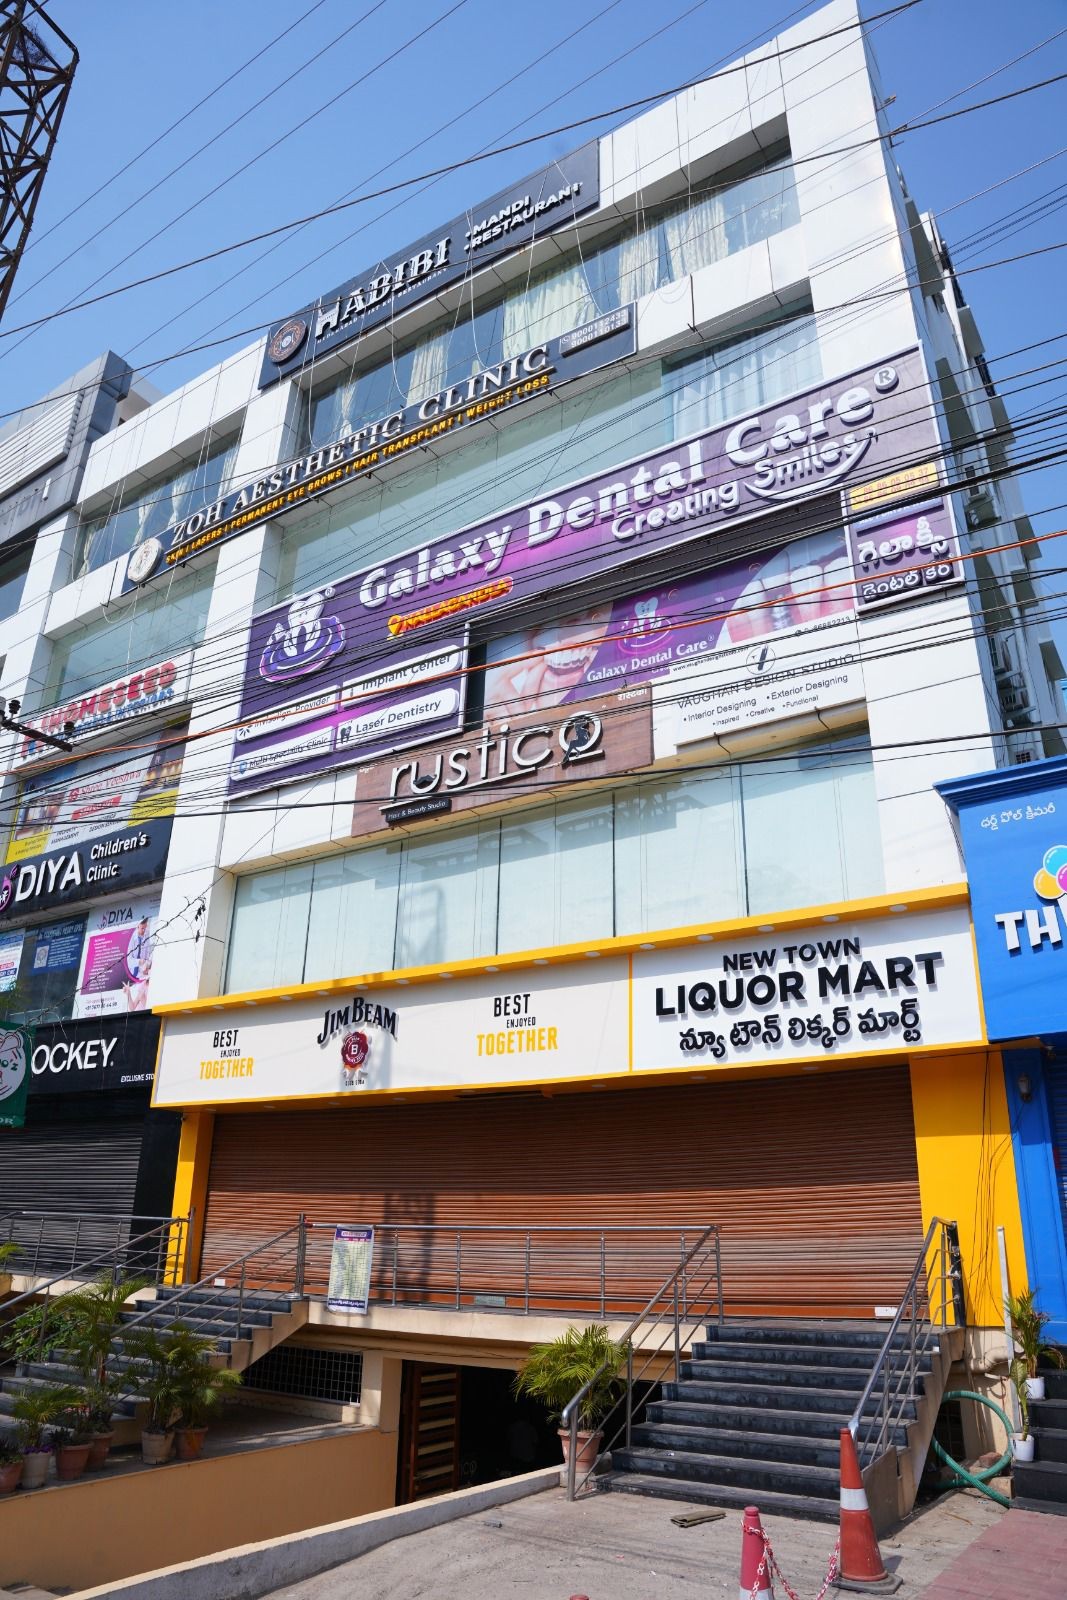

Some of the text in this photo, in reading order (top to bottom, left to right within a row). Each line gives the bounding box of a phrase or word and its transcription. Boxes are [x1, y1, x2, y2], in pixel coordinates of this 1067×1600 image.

[471, 182, 583, 248] RESTAURANT
[472, 195, 531, 236] MANDI
[315, 236, 451, 339] HABIBI
[171, 345, 548, 546] ZOH AESTHETIC CLINIC
[191, 527, 224, 550] LASERS
[230, 496, 286, 530] PERMANENT
[287, 485, 305, 502] EYE
[308, 469, 343, 492] BROWS
[352, 452, 379, 470] HAIR
[382, 416, 455, 456] TRANSPLANT
[517, 375, 550, 396] LOSS
[359, 524, 511, 608] Galaxy
[527, 441, 705, 547] Dental
[725, 385, 876, 467] Care
[610, 434, 868, 542] Creating Smiles
[587, 663, 627, 682] Galaxy
[631, 648, 672, 670] Dental
[676, 640, 708, 656] Care
[356, 699, 442, 734] Laser Dentistry
[688, 675, 848, 722] Interior Designing Exterior Designing
[716, 695, 819, 727] Inspired Creative Functional
[407, 805, 427, 816] Beauty
[427, 801, 446, 811] Studio
[90, 831, 147, 860] Children's
[15, 851, 81, 902] DIYA
[86, 861, 119, 882] Clinic
[108, 907, 133, 925] DIYA
[722, 937, 861, 972] NEW TOWN
[655, 951, 944, 1016] LIQUOR MART
[317, 996, 398, 1045] JIM BEAM
[493, 993, 531, 1018] BEST
[506, 1016, 536, 1029] ENJOYED
[213, 1029, 239, 1048] BEST
[476, 1026, 558, 1057] TOGETHER
[679, 998, 921, 1058] న్యూ టౌన్ లిక్కర్ మార్ట్
[31, 1037, 118, 1075] OCKEY.
[200, 1056, 254, 1080] TOGETHER
[220, 1048, 241, 1058] ENJOYED
